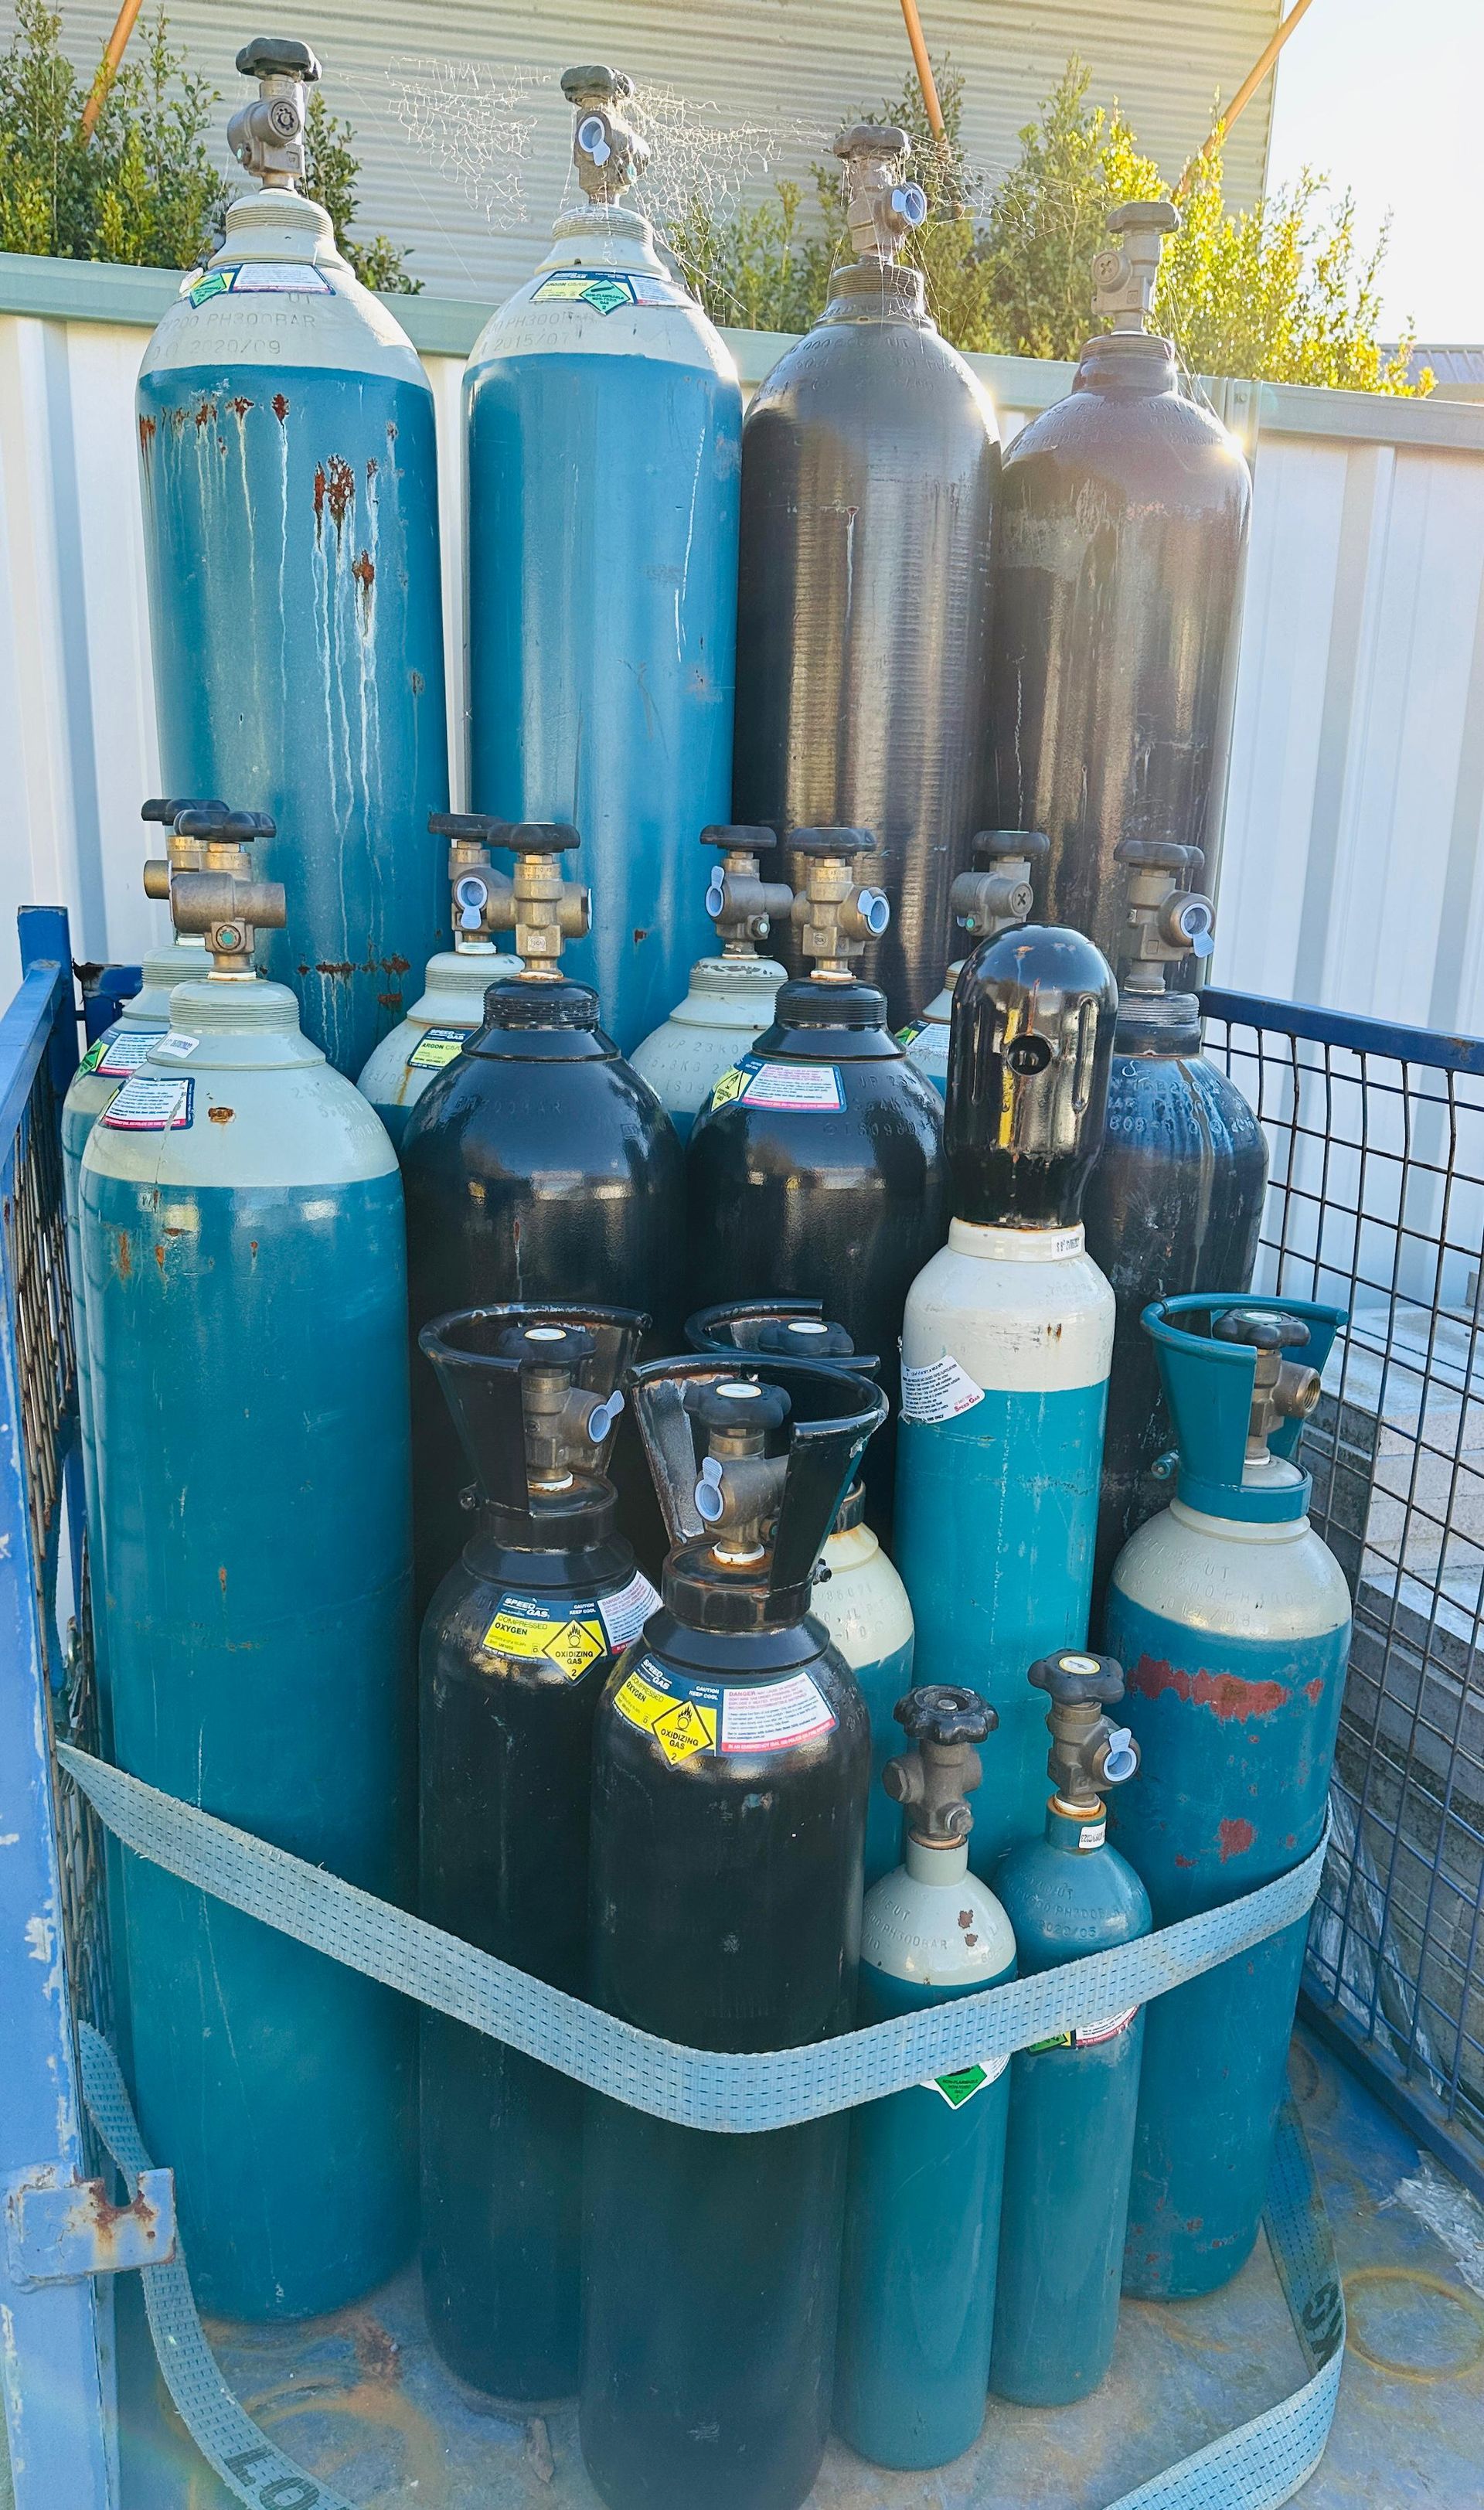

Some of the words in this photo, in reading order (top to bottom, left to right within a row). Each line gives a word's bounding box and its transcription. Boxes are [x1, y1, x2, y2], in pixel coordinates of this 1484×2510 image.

[504, 1597, 536, 1609] SPEED
[526, 1609, 549, 1618] GAS
[498, 1614, 548, 1630] COMPRESSED
[495, 1623, 528, 1636] OXYGEN
[555, 1650, 594, 1658] OXIDIZING
[571, 1668, 577, 1677] 2
[643, 1658, 664, 1678] SPEED
[631, 1674, 665, 1703] COMPRESSED
[652, 1677, 670, 1691] GAS
[696, 1685, 720, 1694] CAUTION
[626, 1681, 647, 1702] OXYGEN
[660, 1728, 699, 1747] OXIDIZING
[669, 1739, 686, 1751] GAS
[670, 1752, 678, 1762] 2
